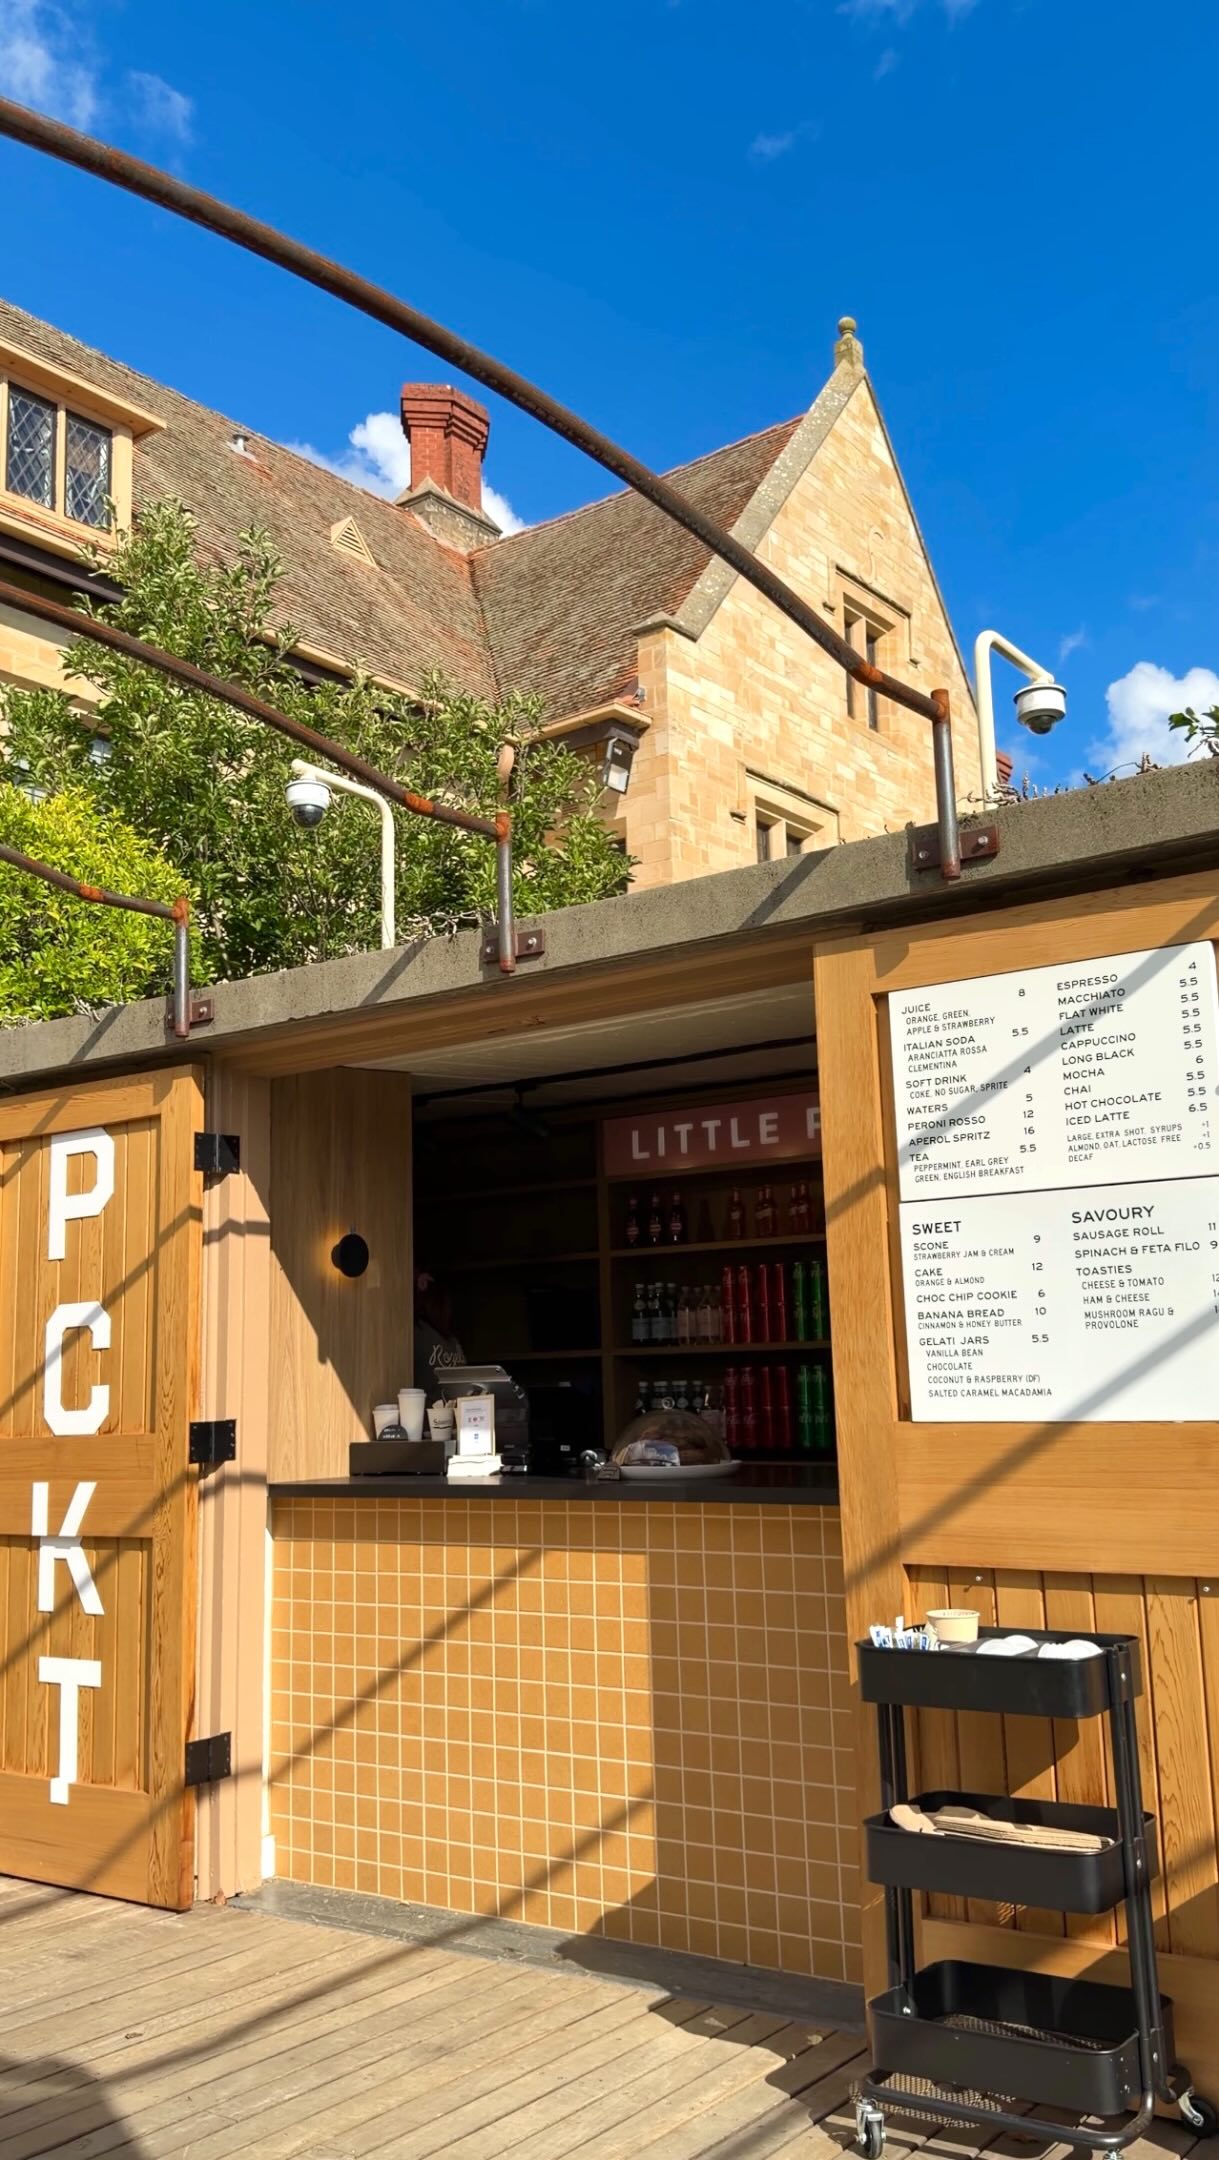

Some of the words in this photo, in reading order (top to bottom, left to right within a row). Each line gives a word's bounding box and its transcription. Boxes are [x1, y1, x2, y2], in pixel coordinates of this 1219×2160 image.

[1057, 974, 1118, 991] ESPRESSO
[1188, 961, 1196, 970] 4
[1058, 988, 1126, 1006] MACCHIATO
[1179, 977, 1198, 988] 5.5
[901, 1003, 931, 1015] JUICE
[1018, 988, 1025, 997] 8
[1059, 1009, 1086, 1021] FLAT
[1088, 1003, 1123, 1017] WHITE
[1180, 992, 1199, 1003] 5.5
[906, 1025, 932, 1036] APPLE
[934, 1024, 939, 1032] &
[942, 1017, 995, 1031] STRAWBERRY
[1060, 1023, 1095, 1036] LATTE
[1181, 1008, 1200, 1019] 5.5
[903, 1040, 943, 1052] ITALIAN
[945, 1035, 976, 1047] SODA
[1012, 1027, 1029, 1037] 5.5
[1060, 1032, 1136, 1051] CAPPUCCINO
[1182, 1023, 1201, 1034] 5.5
[908, 1049, 958, 1062] ARANCIATTA
[960, 1045, 987, 1056] ROSSA
[1062, 1054, 1093, 1066] LONG
[1096, 1048, 1135, 1061] BLACK
[1184, 1039, 1203, 1050] 5.5
[908, 1060, 957, 1073] CLEMENTINA
[1063, 1068, 1105, 1081] MOCHA
[1195, 1055, 1204, 1064] 6
[905, 1078, 932, 1089] SOFT
[934, 1074, 967, 1086] DRINK
[1023, 1065, 1031, 1074] 4
[1063, 1085, 1092, 1095] CHAI
[1186, 1071, 1205, 1081] 5.5
[935, 1088, 946, 1096] NO
[980, 1081, 1008, 1091] SPRITE
[907, 1103, 948, 1115] WATERS
[1025, 1093, 1033, 1102] 5
[1065, 1100, 1088, 1111] HOT
[1090, 1092, 1162, 1108] CHOCOLATE
[1187, 1087, 1206, 1097] 5.5
[908, 1119, 946, 1131] PERONI
[949, 1115, 986, 1127] ROSSO
[1023, 1110, 1034, 1118] 12
[1066, 1115, 1092, 1126] ICED
[1095, 1111, 1130, 1123] LATTE
[1188, 1102, 1208, 1113] 6.5
[631, 1112, 780, 1160] LITTLE
[909, 1135, 950, 1147] APEROL
[953, 1131, 991, 1143] SPRITZ
[1024, 1126, 1035, 1135] 16
[1095, 1130, 1120, 1139] EXTRA
[1150, 1123, 1183, 1134] SYRUPS
[1122, 1137, 1157, 1148] LACTOSE
[1161, 1134, 1181, 1143] FREE
[909, 1153, 929, 1162] TEA
[1019, 1143, 1037, 1153] 5.5
[1068, 1153, 1093, 1163] DECAF
[965, 1158, 986, 1168] EARL
[987, 1156, 1009, 1165] GREY
[943, 1170, 976, 1180] ENGLISH
[978, 1166, 1024, 1177] BREAKFAST
[1071, 1205, 1155, 1224] SAVOURY
[912, 1220, 962, 1235] SWEET
[1073, 1228, 1129, 1241] SAUSAGE
[1133, 1226, 1165, 1237] ROLL
[1208, 1222, 1216, 1231] 11
[913, 1241, 949, 1251] SCONE
[1033, 1234, 1041, 1243] 9
[1075, 1246, 1127, 1259] SPINACH
[1130, 1246, 1138, 1255] &
[1141, 1244, 1171, 1254] FETA
[1175, 1241, 1200, 1251] FILO
[913, 1251, 961, 1261] STRAWBERRY
[963, 1250, 979, 1258] JAM
[989, 1248, 1015, 1256] CREAM
[914, 1267, 943, 1277] CAKE
[1032, 1262, 1043, 1271] 12
[1076, 1264, 1132, 1277] TOASTIES
[915, 1278, 945, 1287] ORANGE
[954, 1276, 985, 1285] ALMOND
[1081, 1280, 1116, 1290] CHEESE
[1119, 1280, 1125, 1288] &
[1127, 1276, 1165, 1287] TOMATO
[916, 1293, 946, 1303] CHOC
[948, 1292, 974, 1302] CHIP
[976, 1290, 1017, 1300] COOKIE
[1037, 1289, 1045, 1298] 6
[1083, 1296, 1103, 1304] HAM
[1106, 1295, 1112, 1303] &
[1115, 1293, 1150, 1303] CHEESE
[918, 1310, 964, 1320] BANANA
[967, 1308, 1005, 1318] BREAD
[1035, 1307, 1047, 1316] 10
[1084, 1309, 1136, 1319] MUSHROOM
[1139, 1307, 1165, 1317] RAGU
[1167, 1307, 1174, 1316] &
[918, 1321, 956, 1330] CINNAMON
[966, 1320, 991, 1328] HONEY
[994, 1319, 1022, 1327] BUTTER
[1085, 1319, 1139, 1329] PROVOLONE
[919, 1337, 955, 1346] GELATI
[960, 1336, 990, 1345] JARS
[1032, 1334, 1049, 1343] 5.5
[926, 1349, 959, 1357] VANILLA
[927, 1362, 973, 1371] CHOCOLATE
[928, 1375, 963, 1384] COCONUT
[966, 1375, 972, 1383] &
[974, 1374, 1023, 1383] RASPBERRY
[928, 1389, 958, 1398] SALTED
[960, 1389, 1000, 1397] CARAMEL
[1001, 1388, 1052, 1397] MACADAMIA
